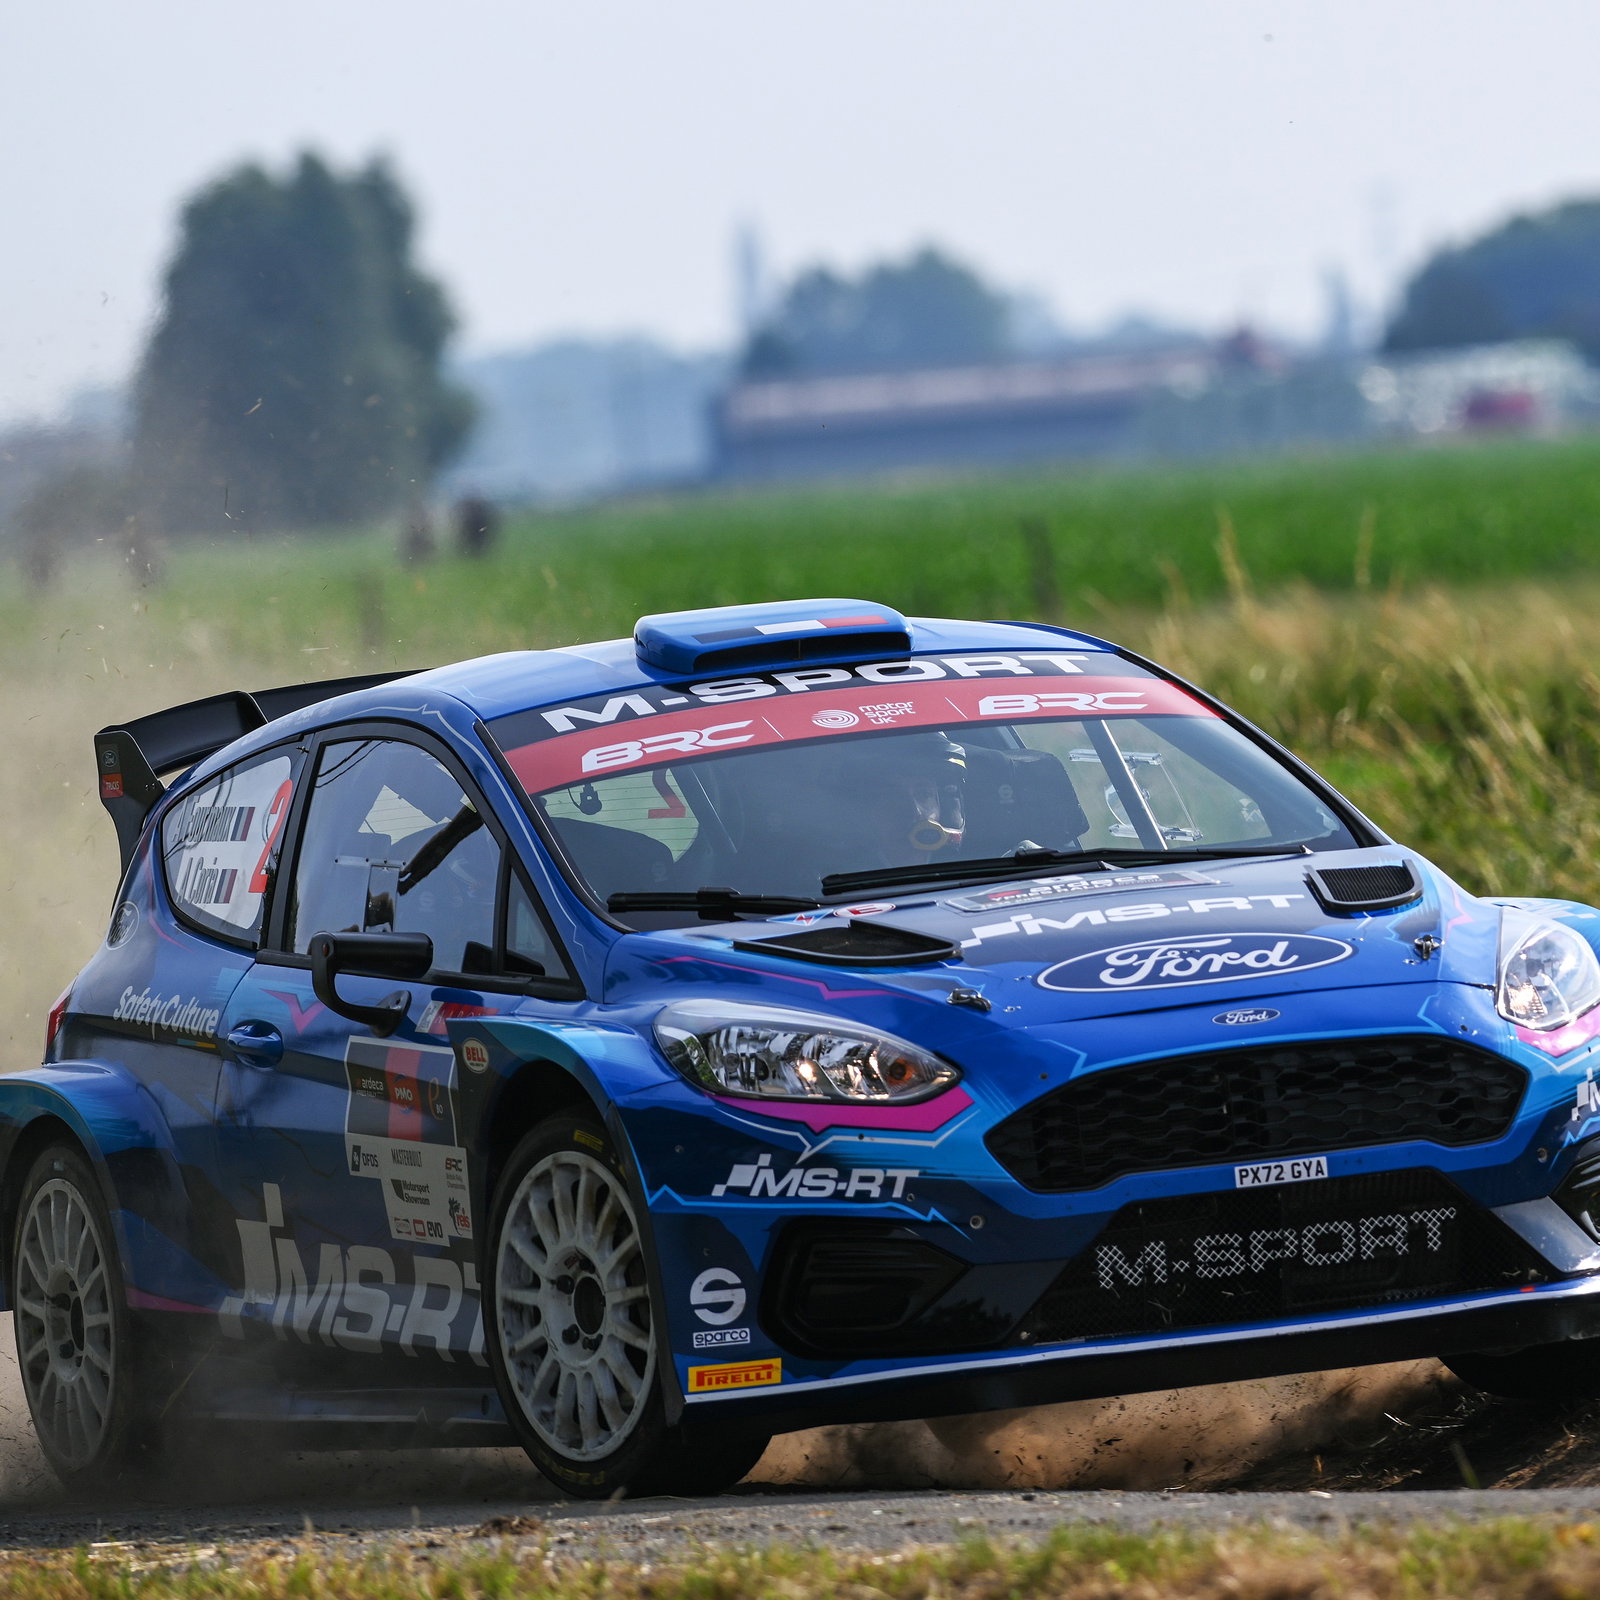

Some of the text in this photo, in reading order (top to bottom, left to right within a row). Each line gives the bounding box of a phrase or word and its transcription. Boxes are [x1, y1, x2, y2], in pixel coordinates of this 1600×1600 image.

[540, 655, 1090, 733] M-SPORT
[979, 692, 1148, 716] BRC
[858, 701, 915, 712] motor
[864, 706, 916, 720] sport
[871, 714, 897, 725] UK
[581, 719, 755, 773] BRC
[248, 778, 294, 894] 2
[1021, 894, 1305, 936] MS-RT
[1099, 938, 1300, 986] Ford
[113, 985, 220, 1040] SafetyCulture
[1225, 1008, 1270, 1025] Ford
[465, 1045, 487, 1063] BELL
[361, 1076, 384, 1091] ardeca
[445, 1157, 463, 1172] BRC
[1239, 1159, 1326, 1186] PX72 GYA
[402, 1179, 430, 1194] Motorsport
[749, 1167, 920, 1198] MS-RT
[403, 1192, 431, 1206] Showroom
[1096, 1206, 1457, 1290] M-SPORT
[695, 1328, 749, 1347] sparco
[695, 1363, 774, 1388] PIRELLI
